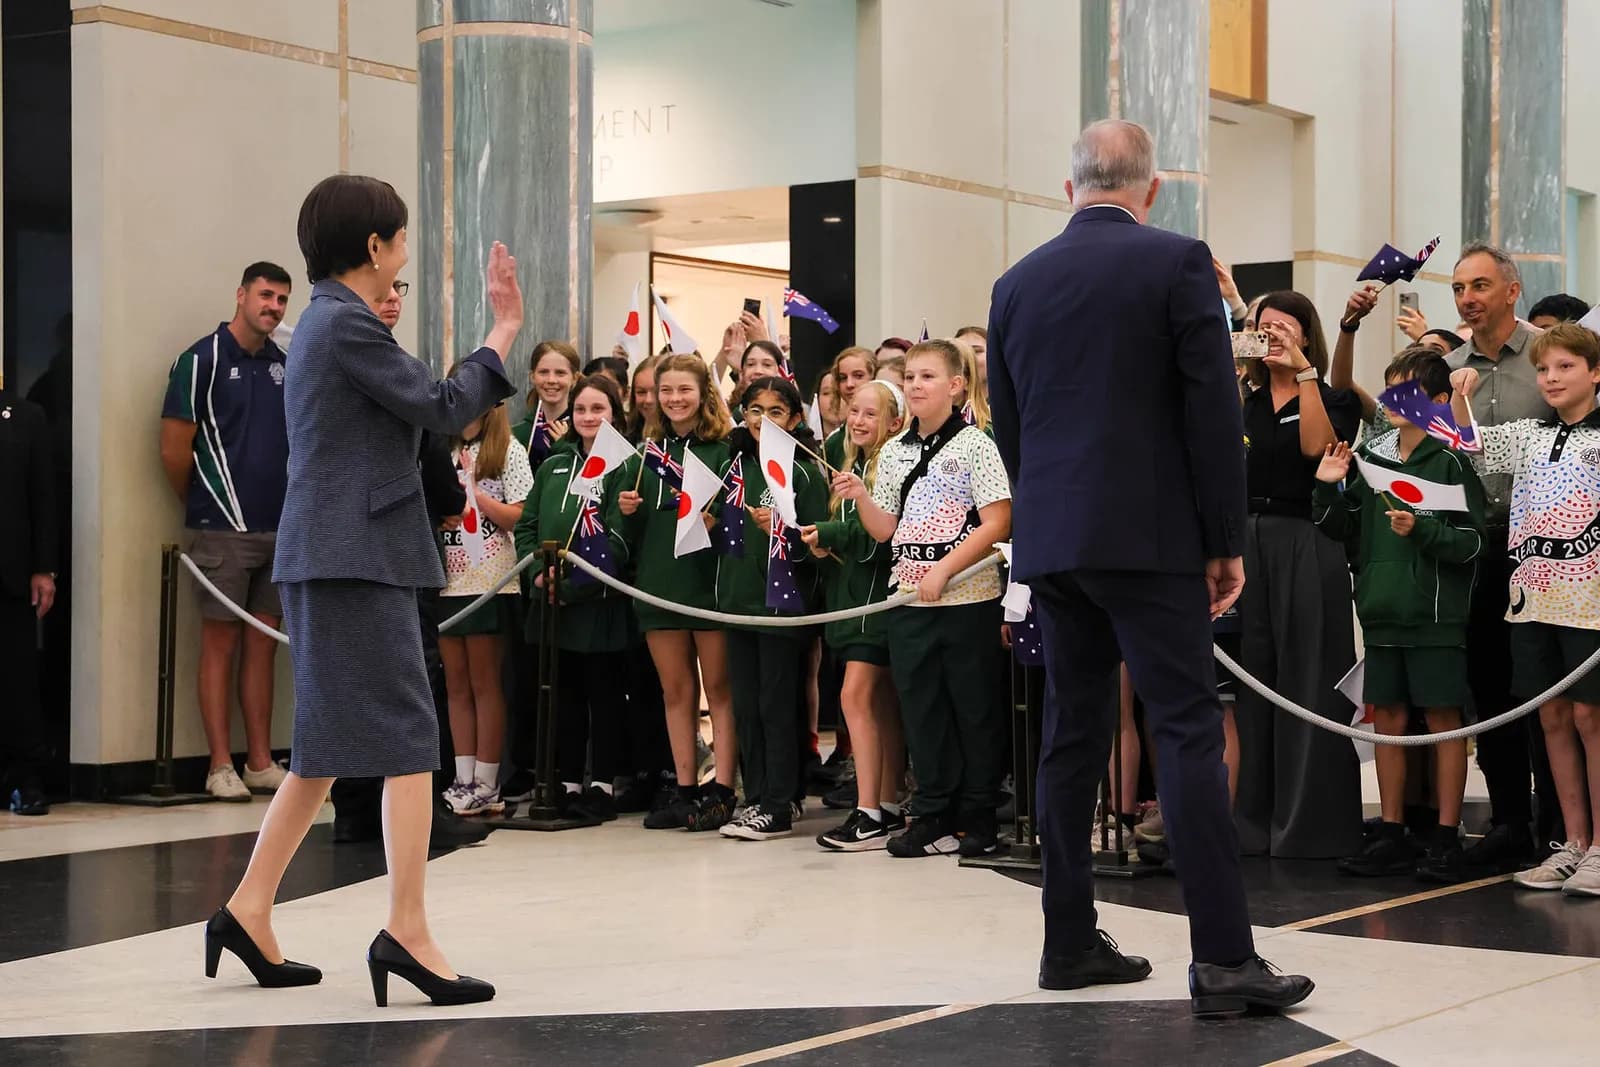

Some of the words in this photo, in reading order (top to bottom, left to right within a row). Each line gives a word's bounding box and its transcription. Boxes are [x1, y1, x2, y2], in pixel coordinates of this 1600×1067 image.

[925, 546, 935, 560] 6
[1508, 539, 1537, 563] YEAR
[1541, 541, 1553, 556] 6
[1562, 526, 1600, 558] 2026
